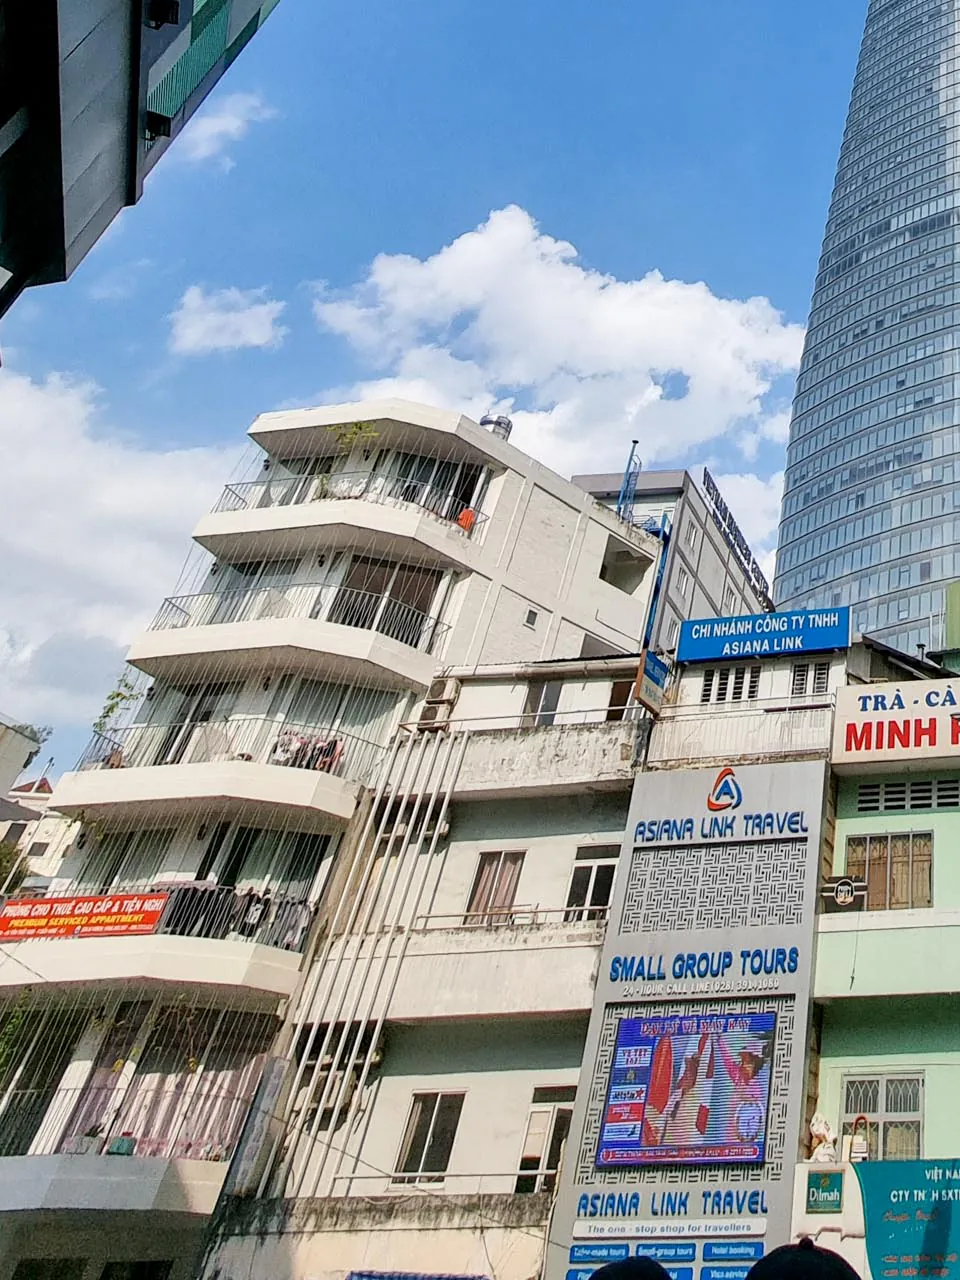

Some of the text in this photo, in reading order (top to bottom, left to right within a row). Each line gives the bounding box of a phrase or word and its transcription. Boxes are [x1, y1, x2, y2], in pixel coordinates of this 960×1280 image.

[692, 613, 839, 639] CHI NHÁNH CÔNG TY TNHH
[723, 636, 803, 656] ASIANA LINK
[858, 689, 905, 711] TRÀ
[925, 685, 956, 707] CÀ
[845, 718, 937, 752] MINH
[634, 811, 808, 842] ASIANA LINK TRAVEL
[74, 901, 94, 914] CAO
[610, 947, 799, 982] SMALL GROUP TOURS
[666, 983, 687, 996] CALL
[577, 1190, 768, 1217] ASIANA LINK TRAVEL
[810, 1188, 840, 1201] Dilmah
[890, 1190, 909, 1203] CTY
[588, 1225, 604, 1233] The
[635, 1225, 657, 1235] stop
[660, 1224, 684, 1234] shop
[687, 1223, 701, 1232] for
[704, 1223, 751, 1232] travellers
